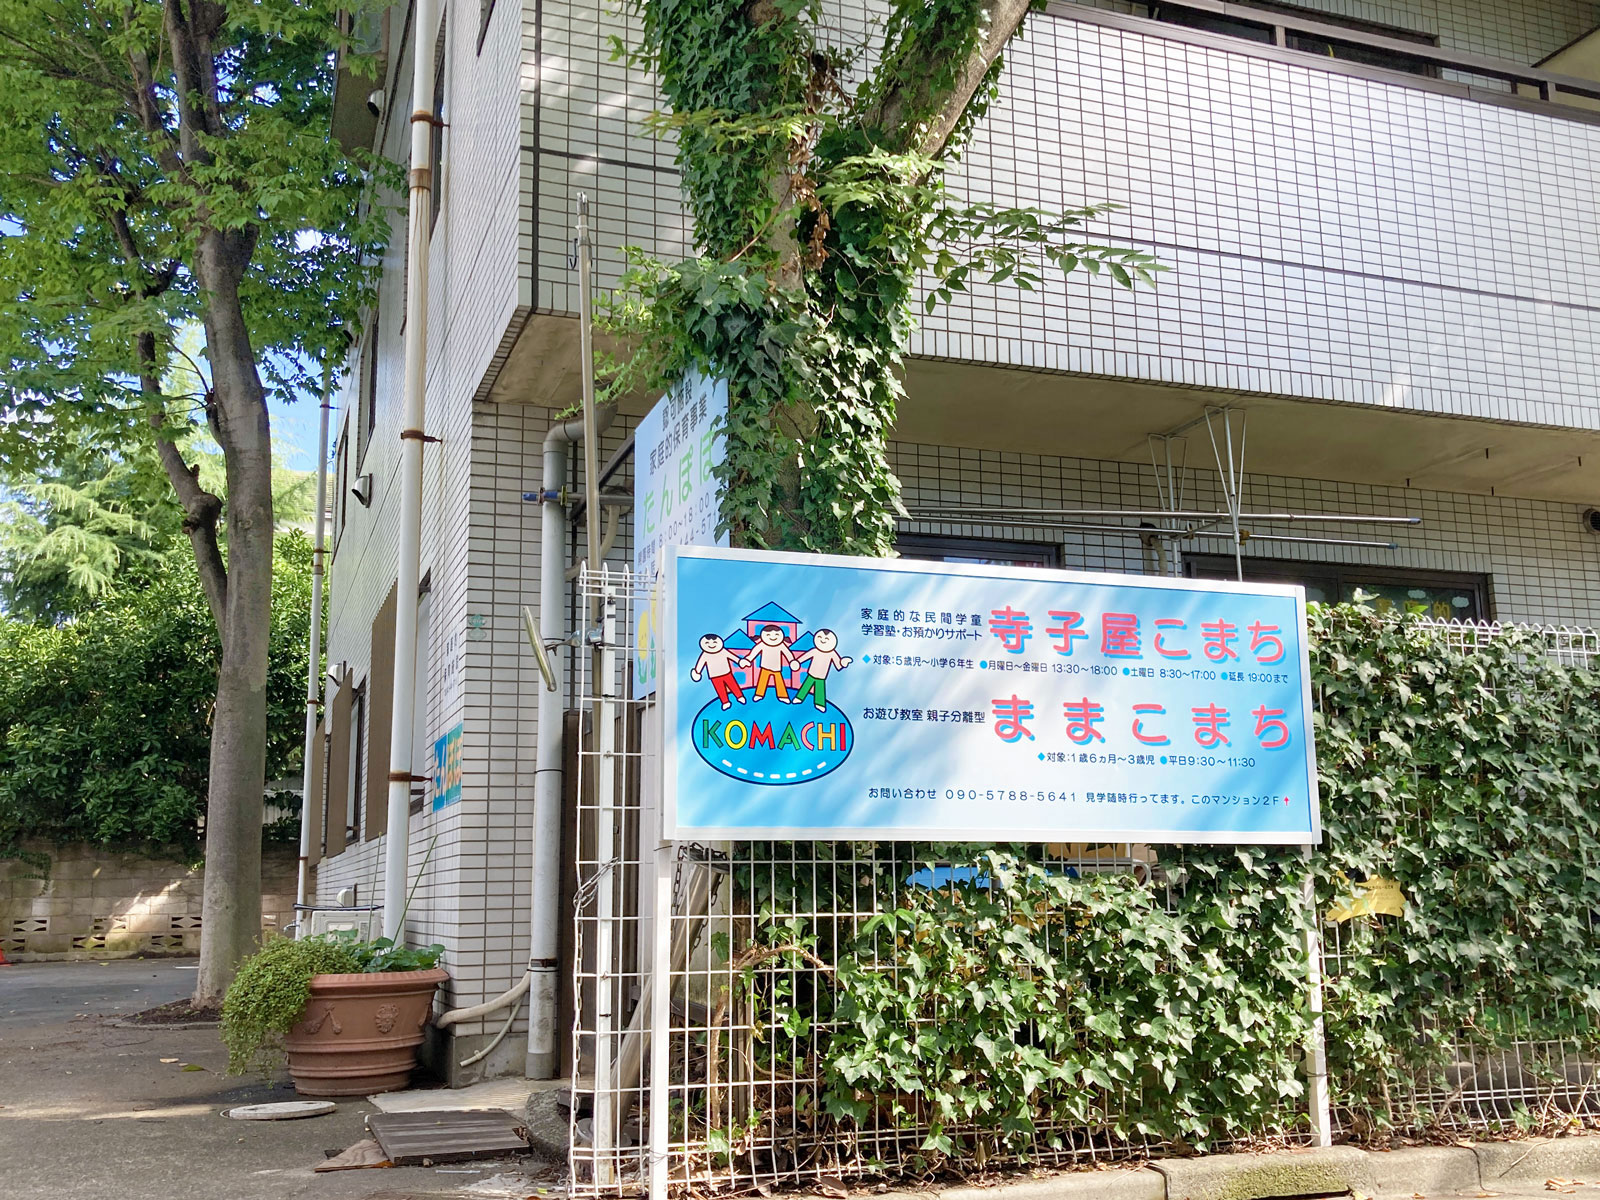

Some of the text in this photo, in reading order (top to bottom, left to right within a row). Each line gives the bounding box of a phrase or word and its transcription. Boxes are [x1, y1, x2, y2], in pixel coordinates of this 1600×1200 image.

[649, 391, 708, 476] 家庭的保育事業
[860, 607, 983, 627] 家庭的な民間学童
[861, 623, 983, 641] 学習塾・お預かりサポート
[988, 605, 1288, 665] 寺子屋こまち
[1130, 667, 1155, 678] 土曜日
[1228, 671, 1245, 683] 延長
[862, 706, 986, 724] お遊び教室 親子分離型
[991, 693, 1292, 751] ままこまち
[702, 719, 847, 752] KOMACHI
[868, 787, 938, 800] お問い合わせ
[945, 789, 1077, 802] 090-5788-5641
[1086, 791, 1186, 805] 見学随時行ってます。
